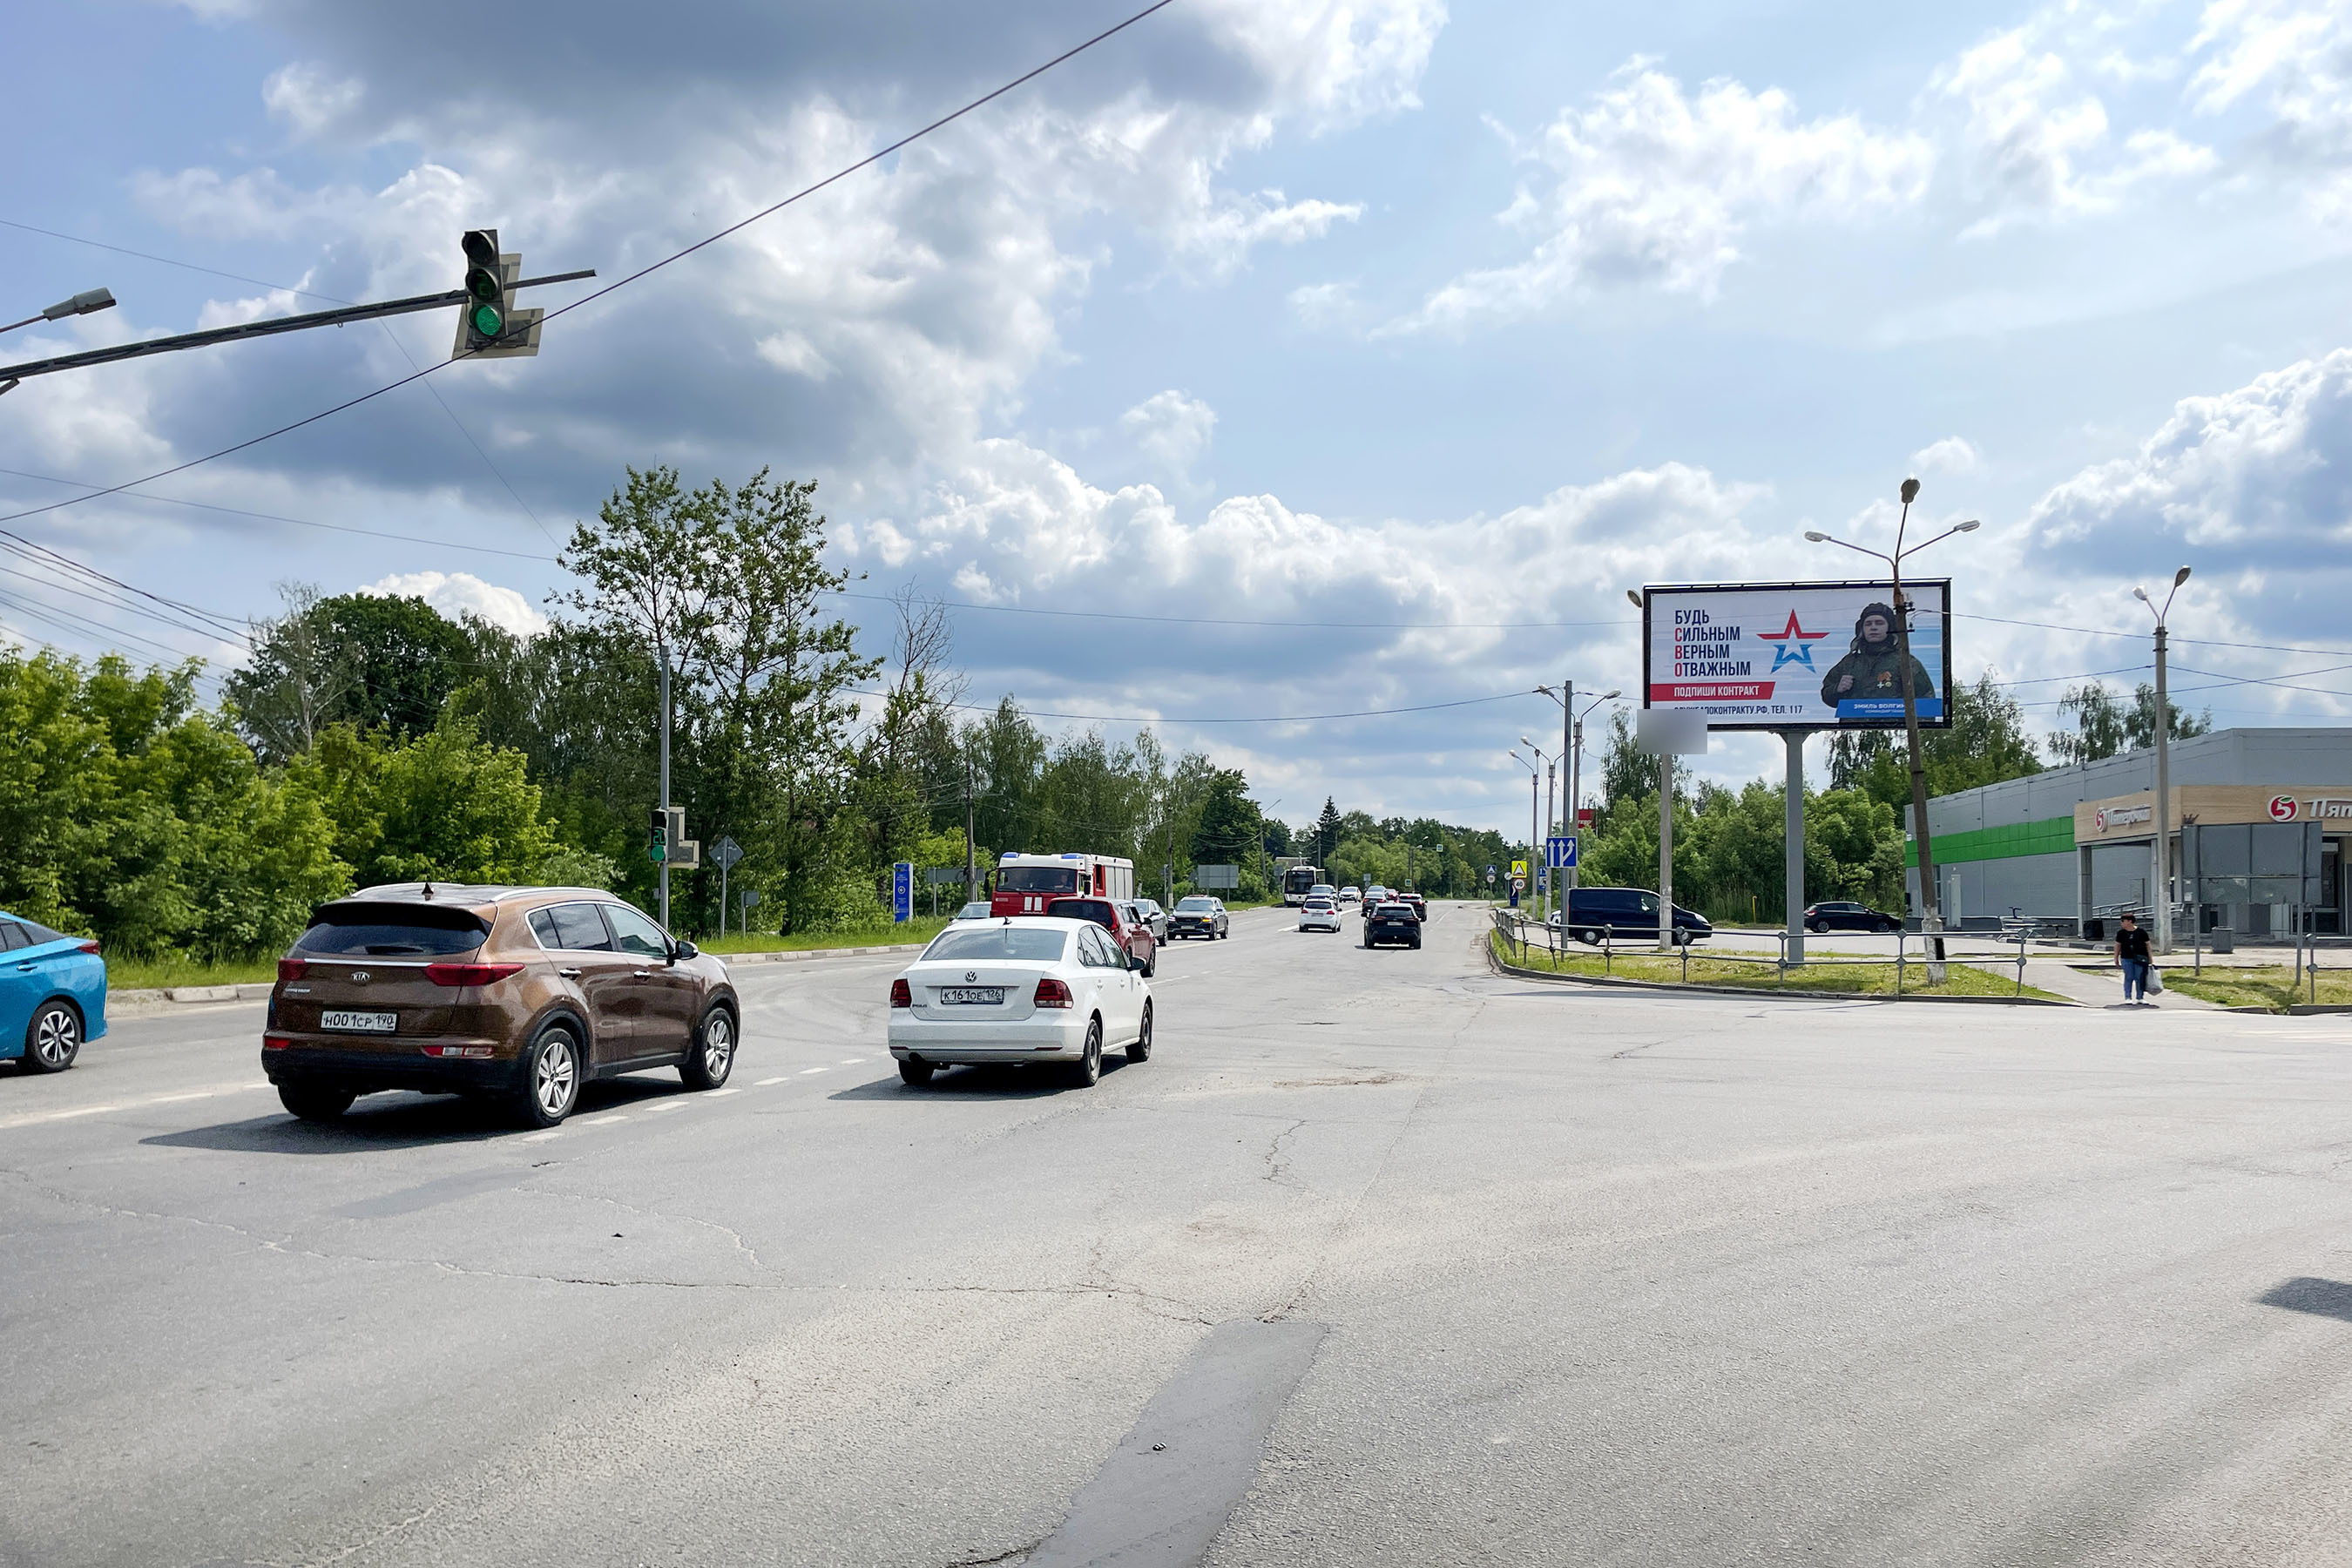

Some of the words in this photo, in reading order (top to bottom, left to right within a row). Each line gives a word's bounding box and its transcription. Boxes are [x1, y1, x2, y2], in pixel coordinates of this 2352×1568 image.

[1674, 610, 1710, 625] БУДЬ
[1674, 626, 1740, 642] СИЛЬНЫМ
[1674, 644, 1730, 659] ВЕРНЫМ
[1674, 661, 1751, 678] ОТВАЖНЫМ
[1673, 686, 1716, 698] ПОДПИШИ
[1717, 686, 1760, 696] КОНТРАКТ
[1674, 706, 1769, 715] ПОКОНТРАКТУ.РФ,
[1771, 706, 1787, 714] ТЕЛ.
[1789, 705, 1803, 714] 117
